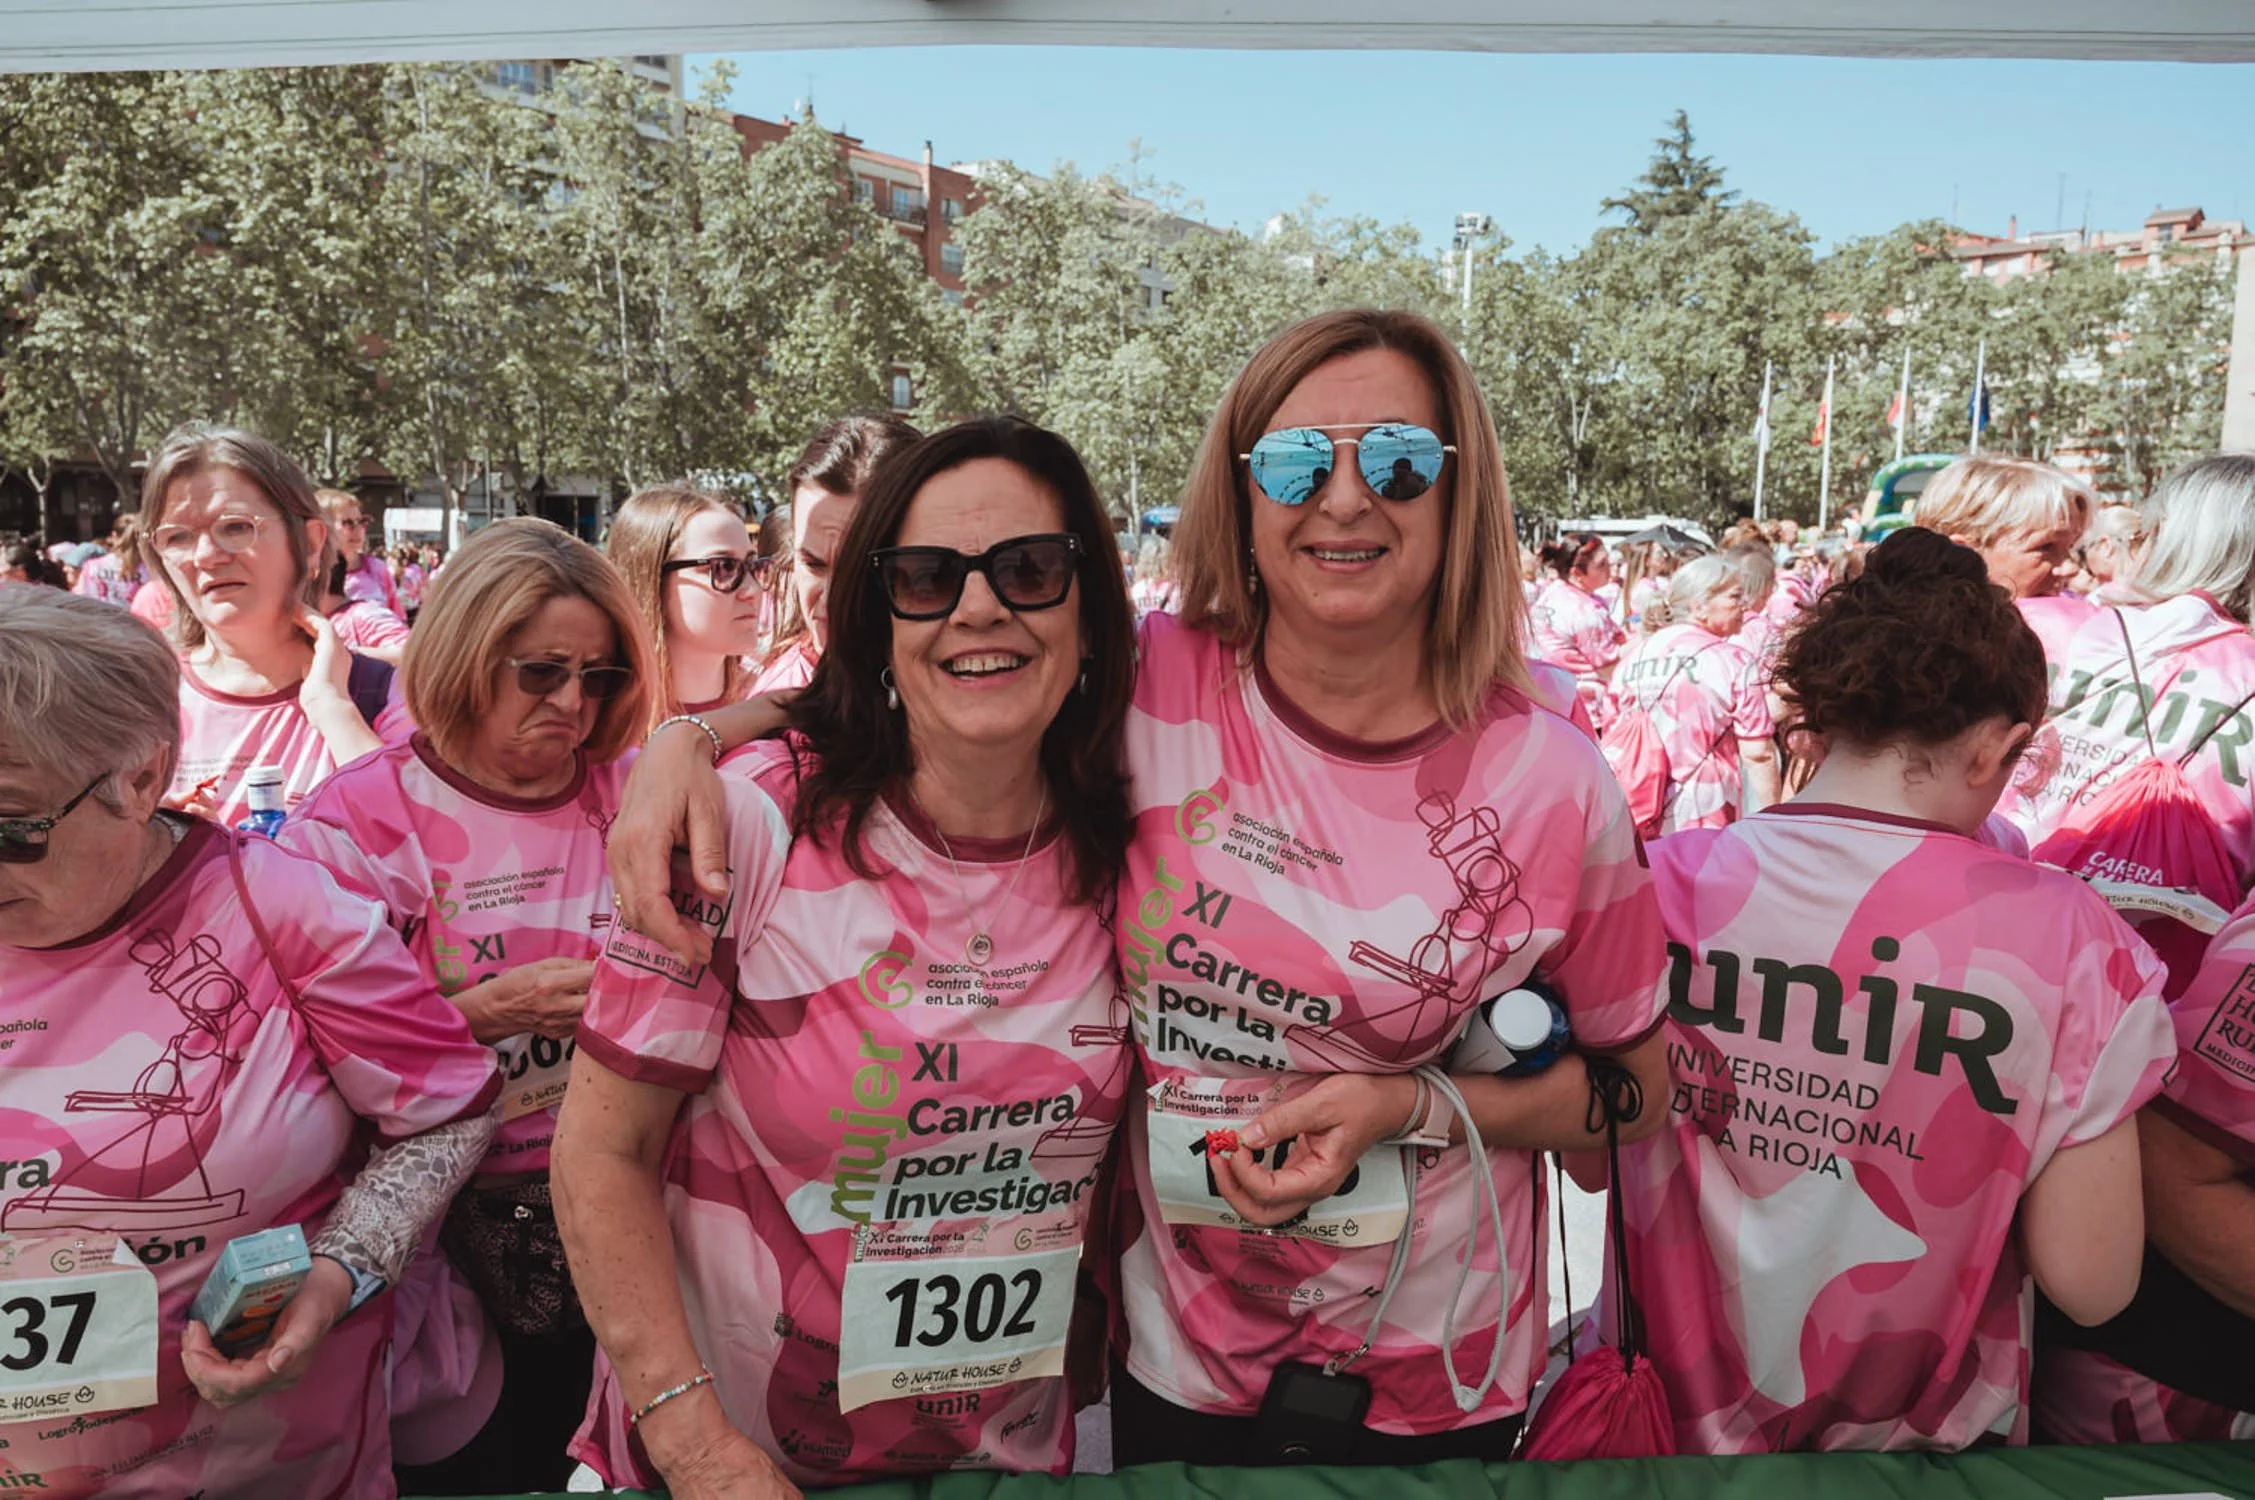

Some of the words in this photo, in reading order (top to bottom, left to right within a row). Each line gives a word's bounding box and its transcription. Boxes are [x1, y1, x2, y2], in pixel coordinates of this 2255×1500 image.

[1228, 828, 1265, 848] contra
[1267, 843, 1279, 855] el
[1293, 837, 1344, 865] española
[1222, 842, 1236, 854] en
[1238, 846, 1252, 861] La
[1254, 853, 1285, 875] Rioja
[466, 887, 500, 900] contra
[502, 886, 512, 895] el
[468, 902, 482, 912] en
[484, 901, 497, 910] La
[500, 894, 525, 906] Rioja
[1182, 880, 1232, 928] XI
[468, 933, 505, 965] XI
[991, 960, 1049, 979] española
[1166, 933, 1332, 1027] Carrera
[926, 979, 971, 990] contra
[925, 996, 943, 1005] en
[947, 994, 963, 1005] La
[968, 993, 999, 1008] Rioja
[1158, 983, 1227, 1023] por
[1237, 1007, 1275, 1042] la
[912, 1042, 958, 1082] XI
[1180, 1090, 1223, 1103] Carrera
[1226, 1095, 1245, 1104] por
[1248, 1094, 1259, 1103] la
[907, 1093, 1074, 1136] Carrera
[830, 1030, 908, 1228] mujer
[893, 1150, 976, 1185] por
[983, 1142, 1022, 1173] la
[1749, 1134, 1843, 1181] RIOJA
[887, 1234, 929, 1244] Carrera
[932, 1233, 953, 1246] por
[955, 1232, 965, 1241] la
[1297, 1223, 1339, 1237] OUSE
[885, 1268, 1042, 1348] 1302
[911, 1369, 958, 1385] NATUR
[962, 1363, 1008, 1380] HOUSE
[12, 1393, 70, 1410] HOUSE
